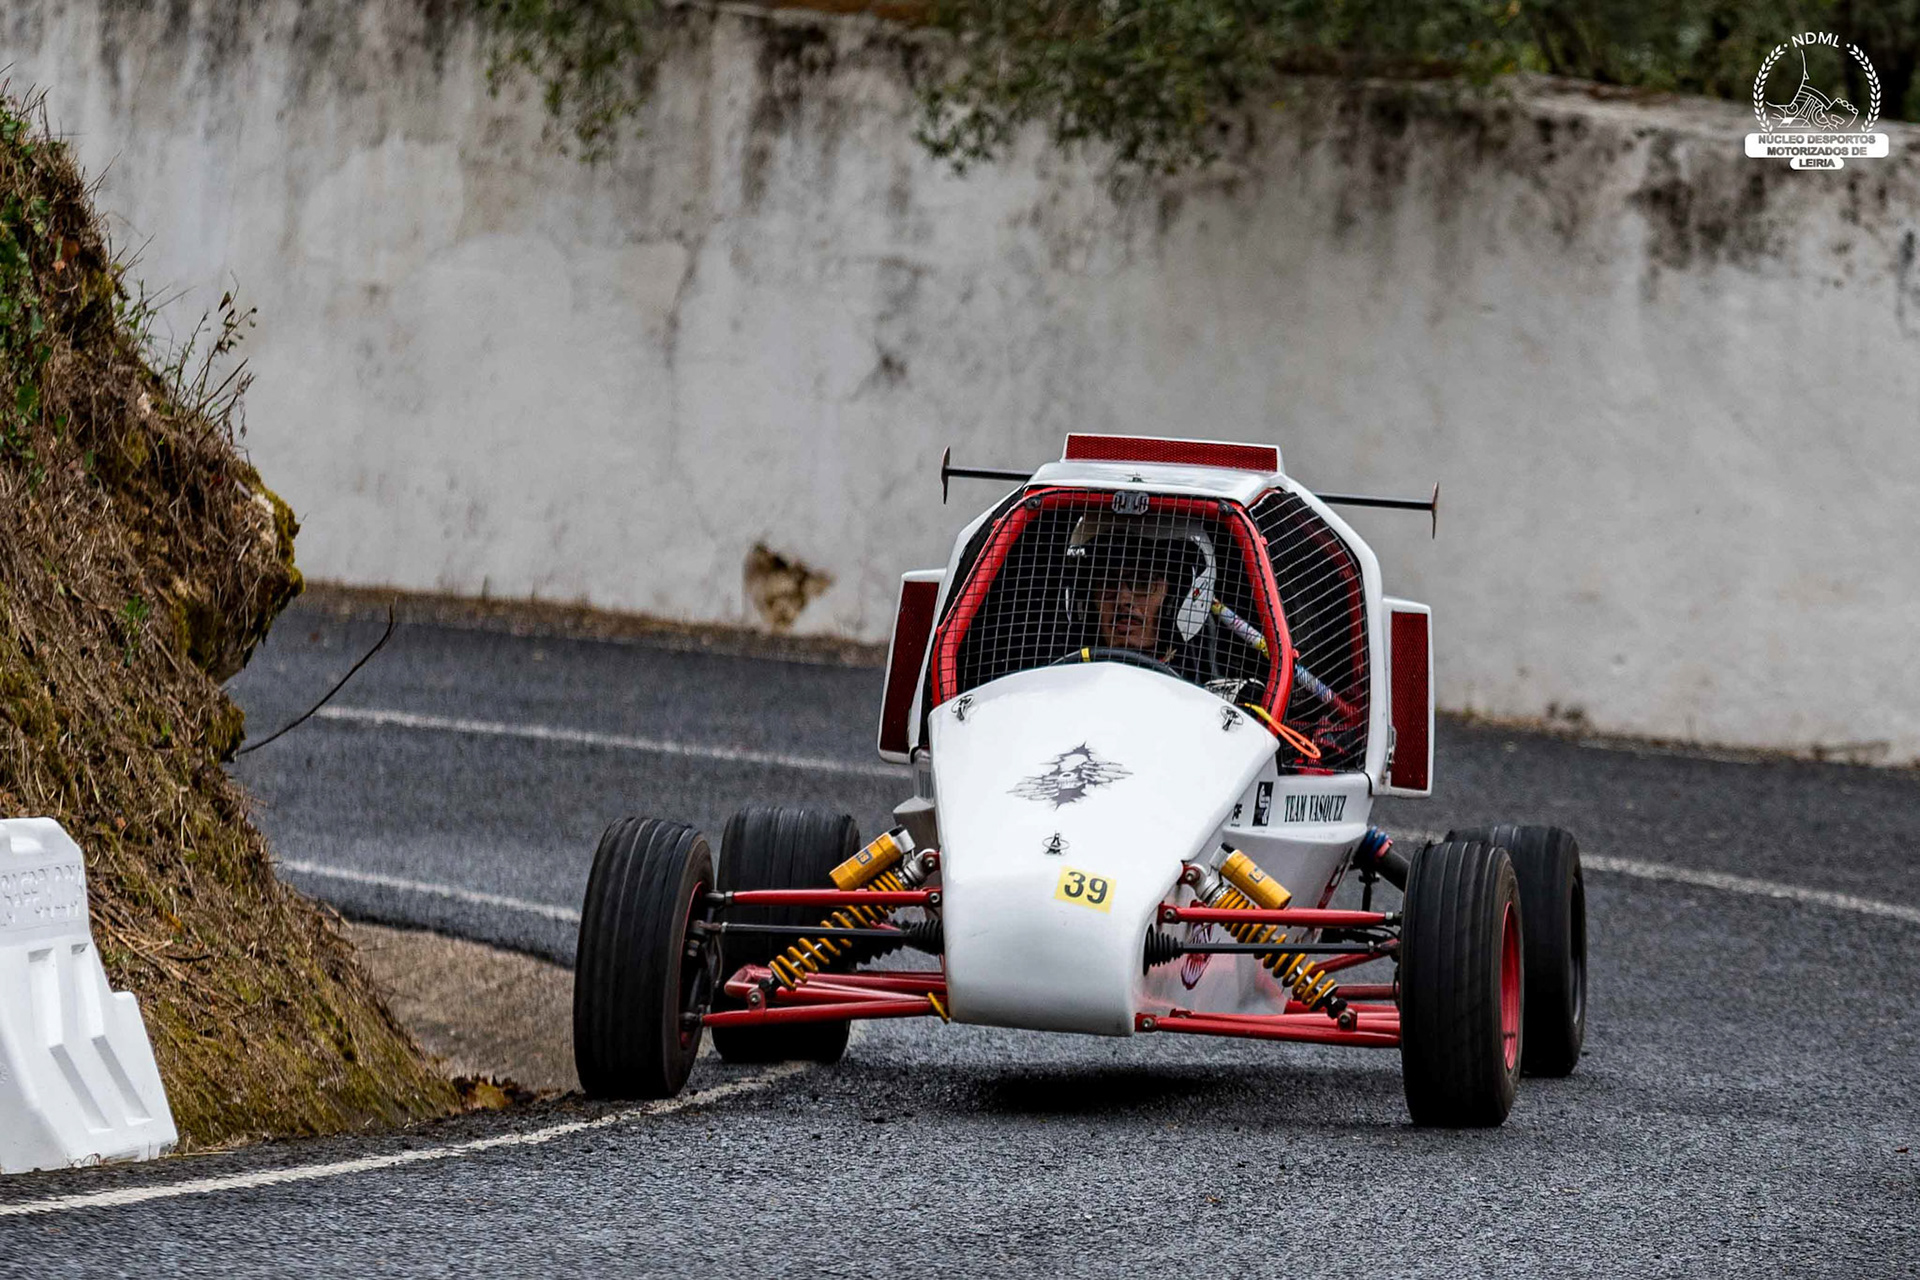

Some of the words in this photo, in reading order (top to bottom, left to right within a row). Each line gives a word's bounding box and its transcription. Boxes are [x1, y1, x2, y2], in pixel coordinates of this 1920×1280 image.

[1284, 794, 1308, 822] TEAM
[1308, 794, 1347, 823] VASQUEZ
[1063, 871, 1108, 905] 39
